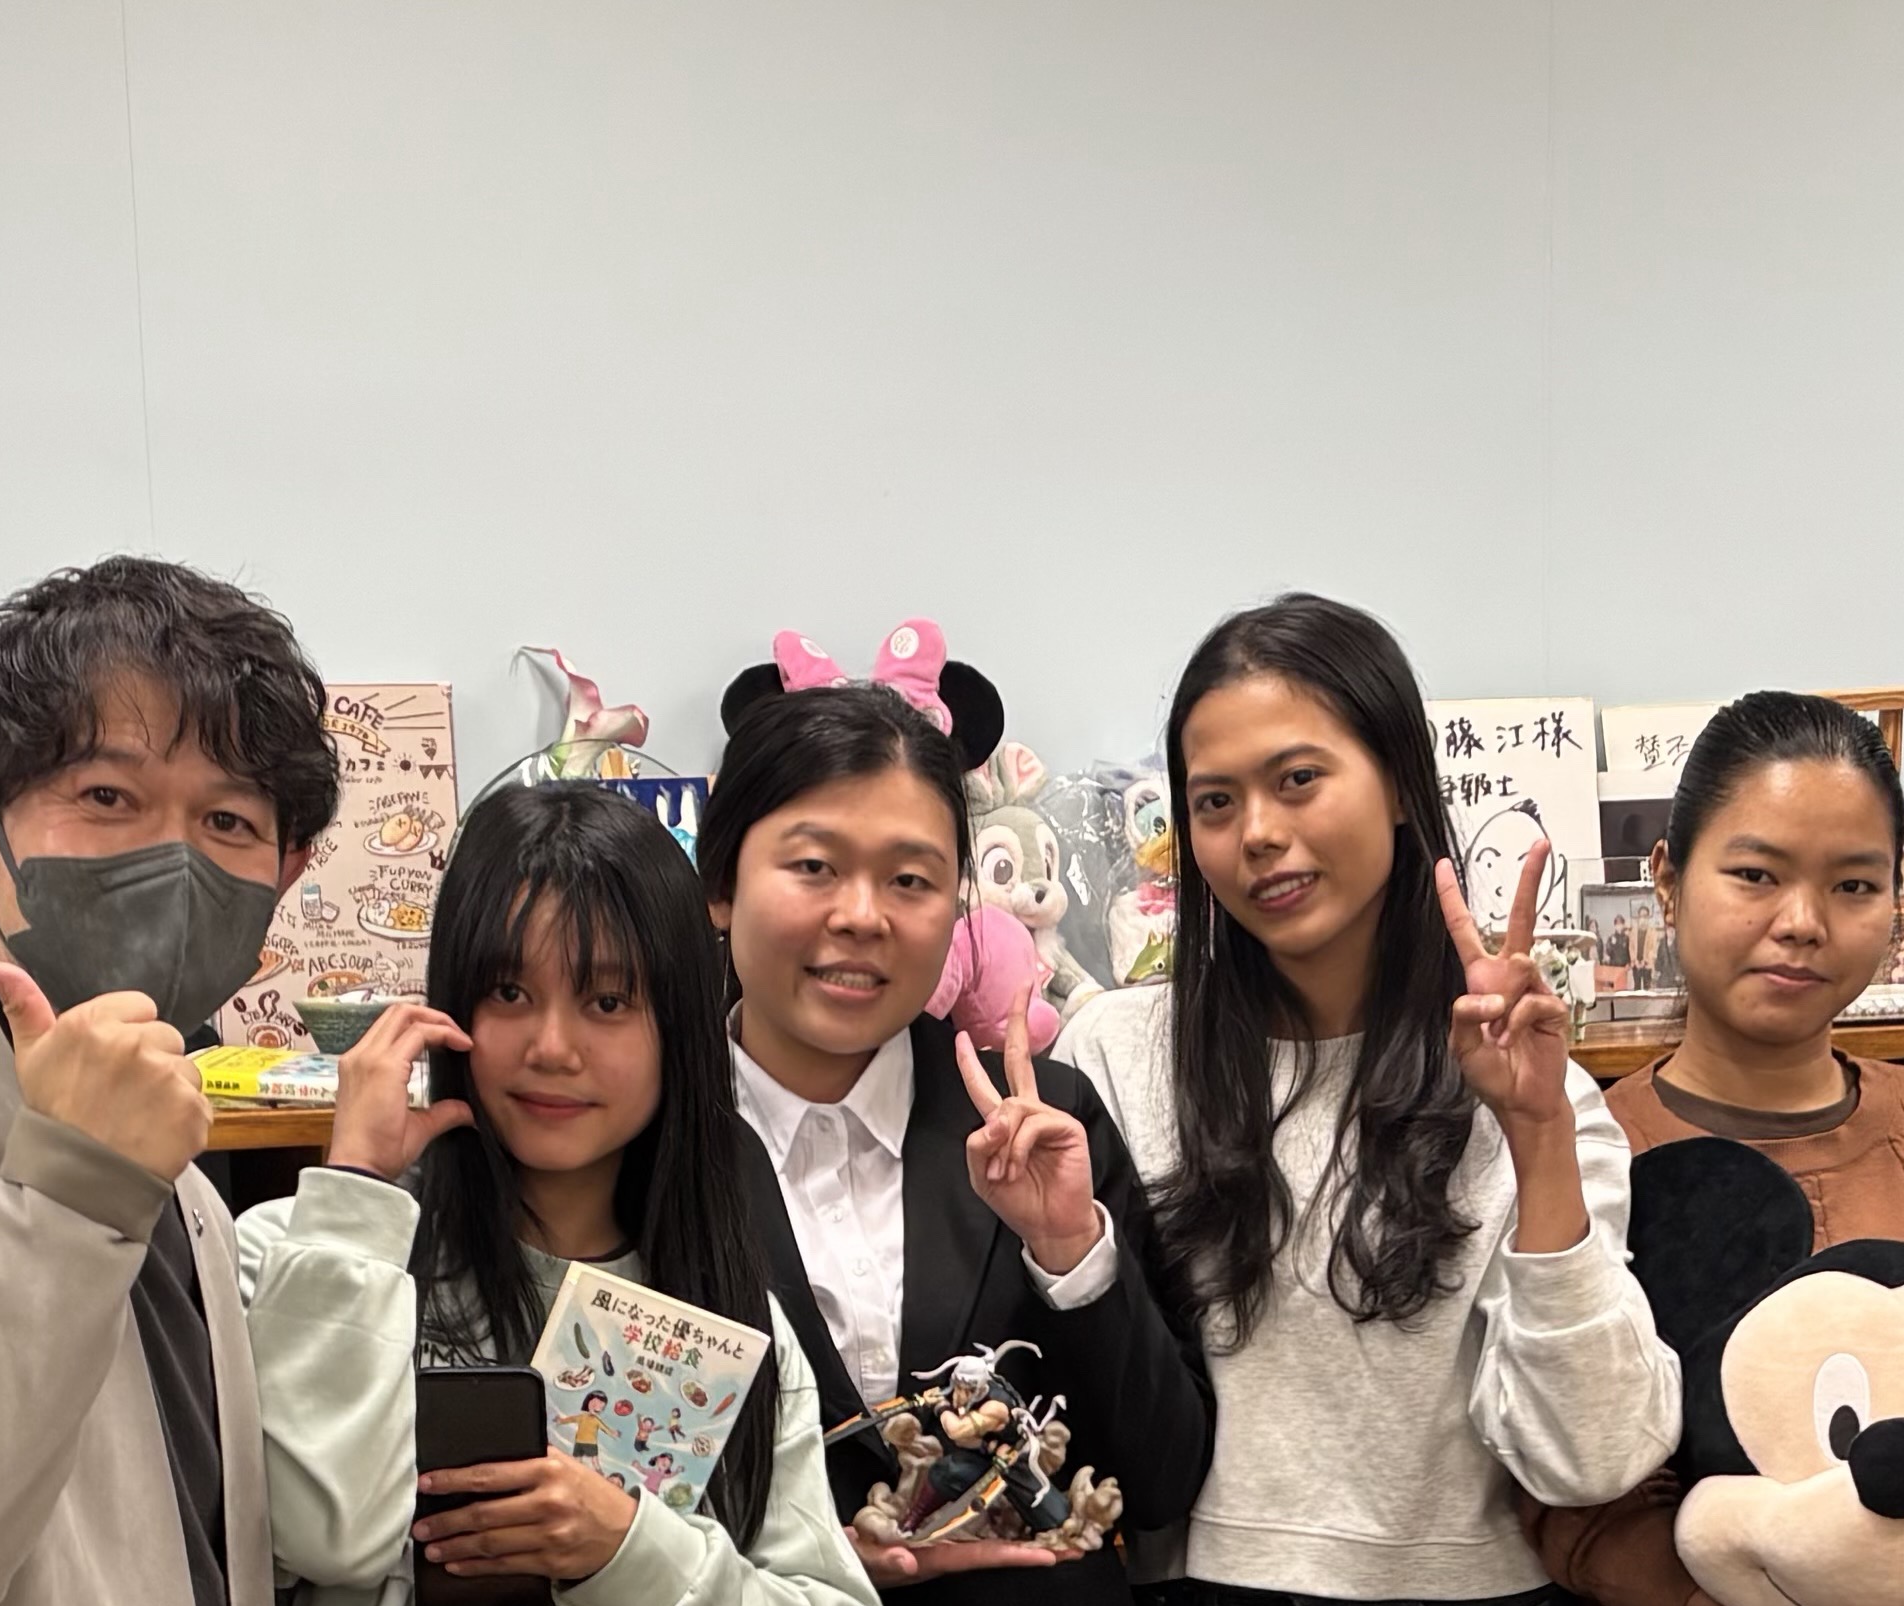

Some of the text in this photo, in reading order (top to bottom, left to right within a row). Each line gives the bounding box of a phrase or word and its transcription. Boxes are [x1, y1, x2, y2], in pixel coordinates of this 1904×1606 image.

[333, 695, 386, 731] CAFE
[589, 1288, 746, 1361] 風になった優ちゃんと
[622, 1322, 704, 1371] 学校給食
